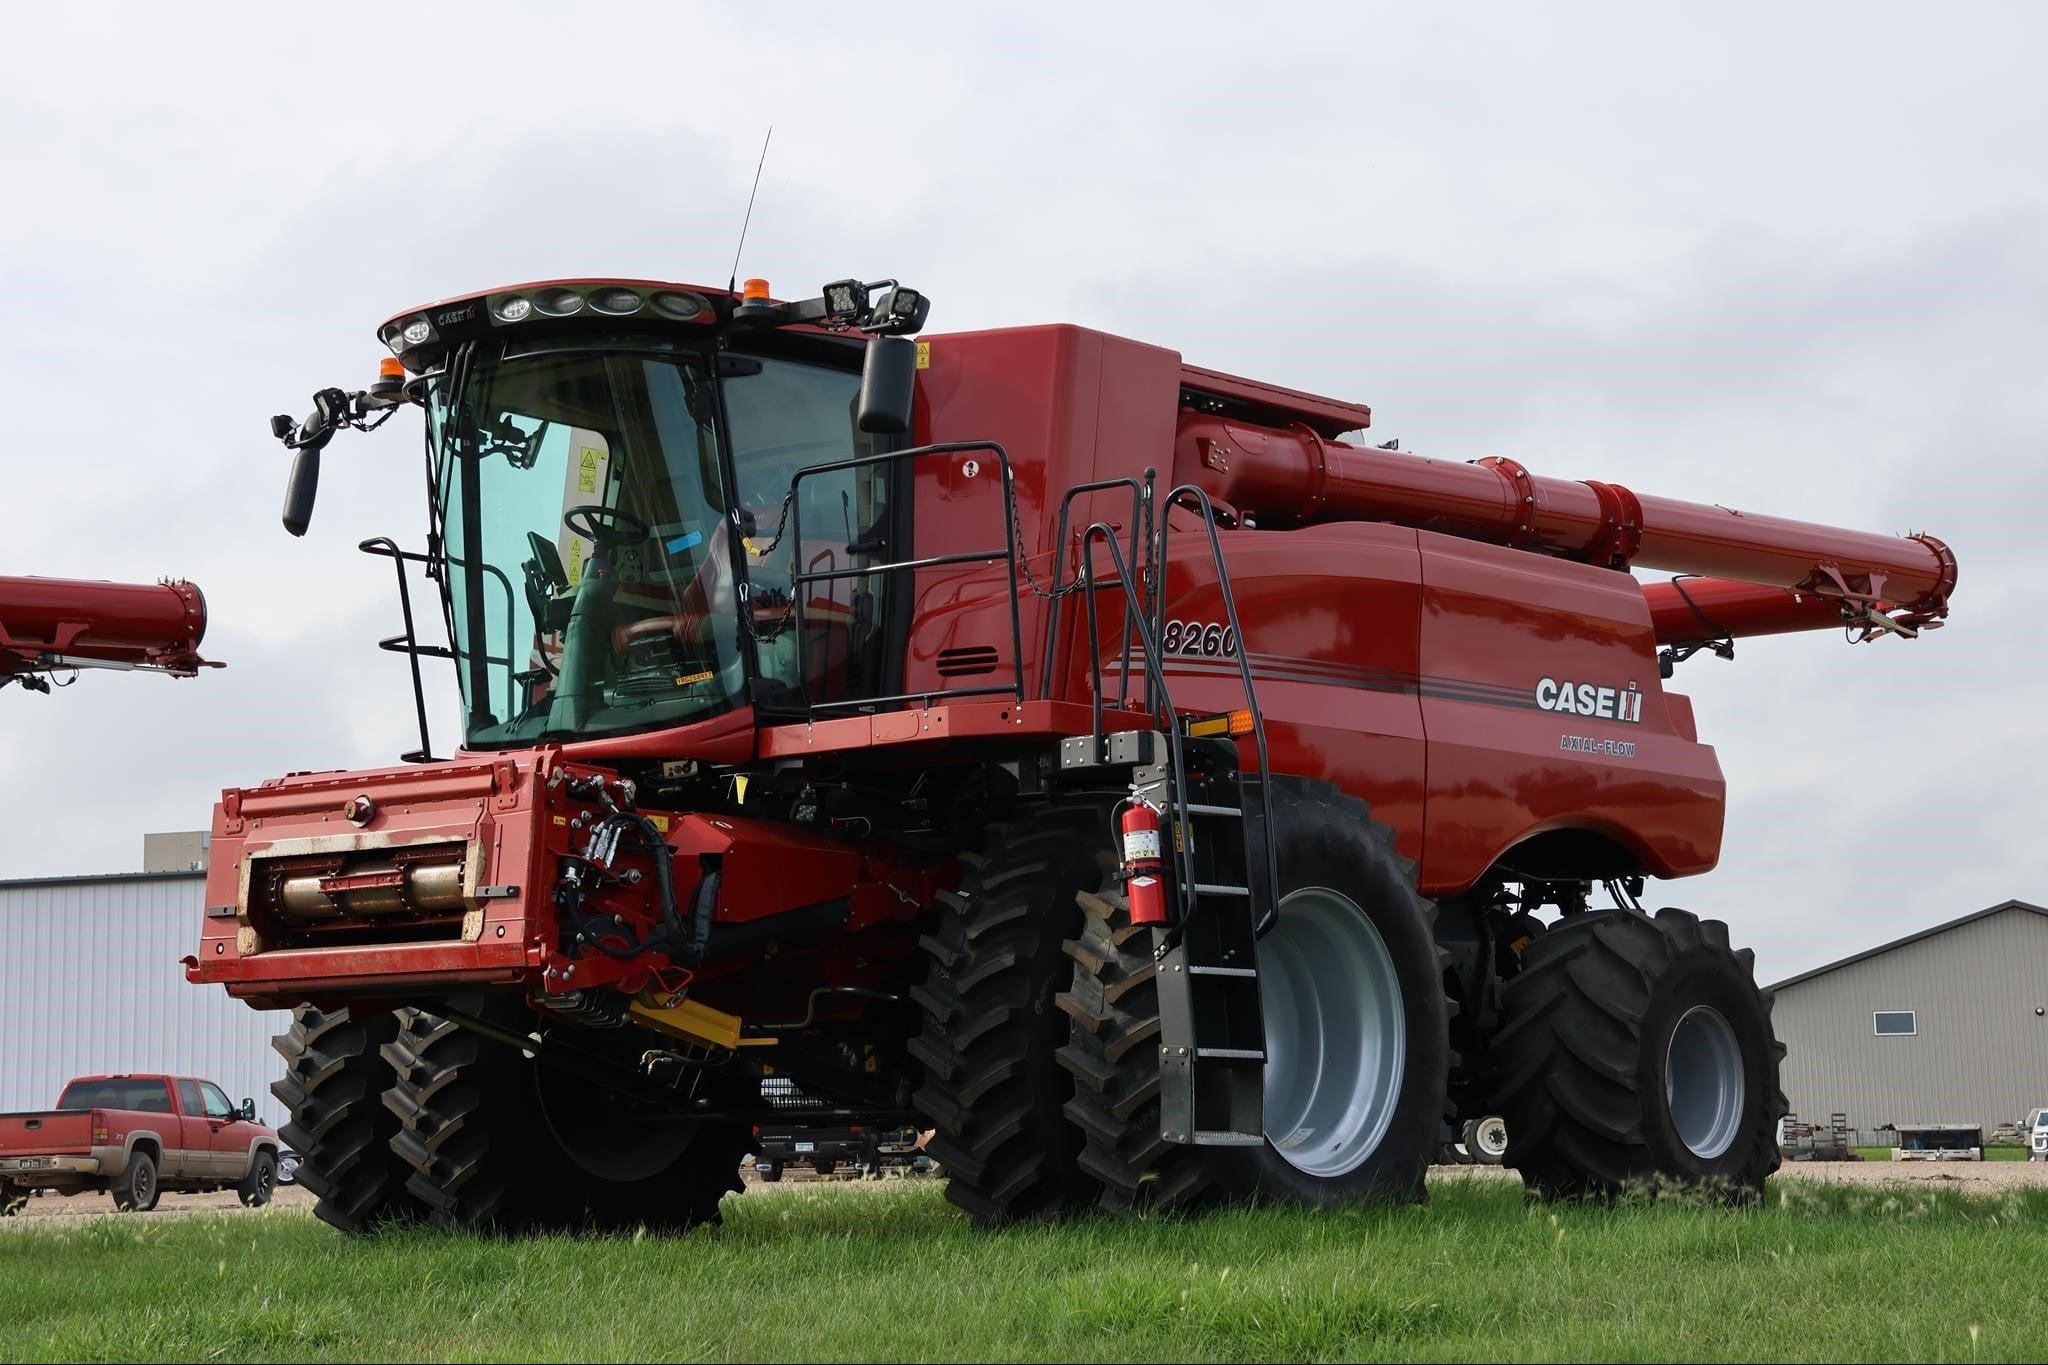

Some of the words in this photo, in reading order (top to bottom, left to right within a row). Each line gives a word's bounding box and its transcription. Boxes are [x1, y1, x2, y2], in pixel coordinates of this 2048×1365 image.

[1163, 619, 1238, 660] 8260
[1535, 677, 1616, 719] CASE
[1560, 735, 1635, 758] AXIAL-FLOW
